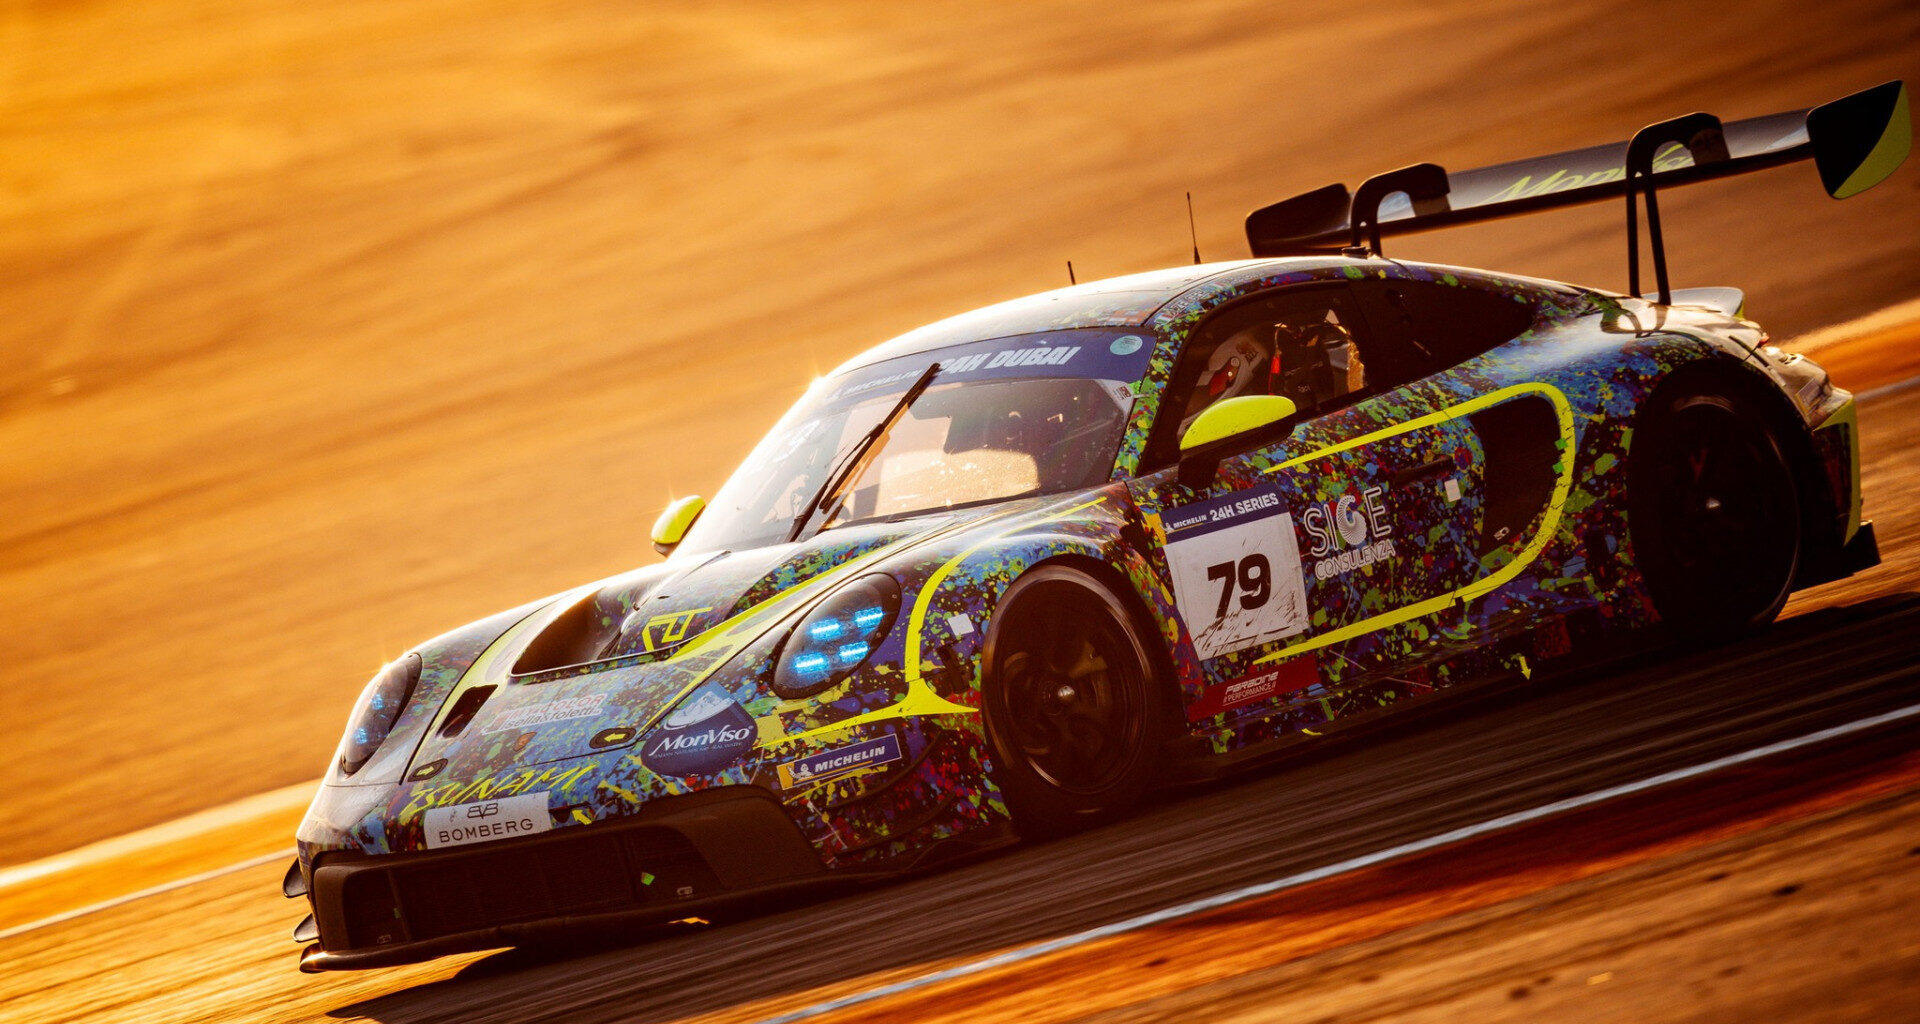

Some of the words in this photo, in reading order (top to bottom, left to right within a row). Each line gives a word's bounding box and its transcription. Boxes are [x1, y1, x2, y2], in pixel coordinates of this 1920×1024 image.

[983, 346, 1082, 369] DUBAI
[1172, 513, 1208, 529] MICHELIN
[1209, 504, 1236, 522] 24H
[1234, 492, 1279, 515] SERIES
[1314, 538, 1396, 581] CONSULENZA
[1207, 553, 1271, 620] 79
[814, 745, 886, 773] MICHELIN
[398, 763, 597, 817] TSUNAMI
[438, 818, 534, 843] BOMBERG
